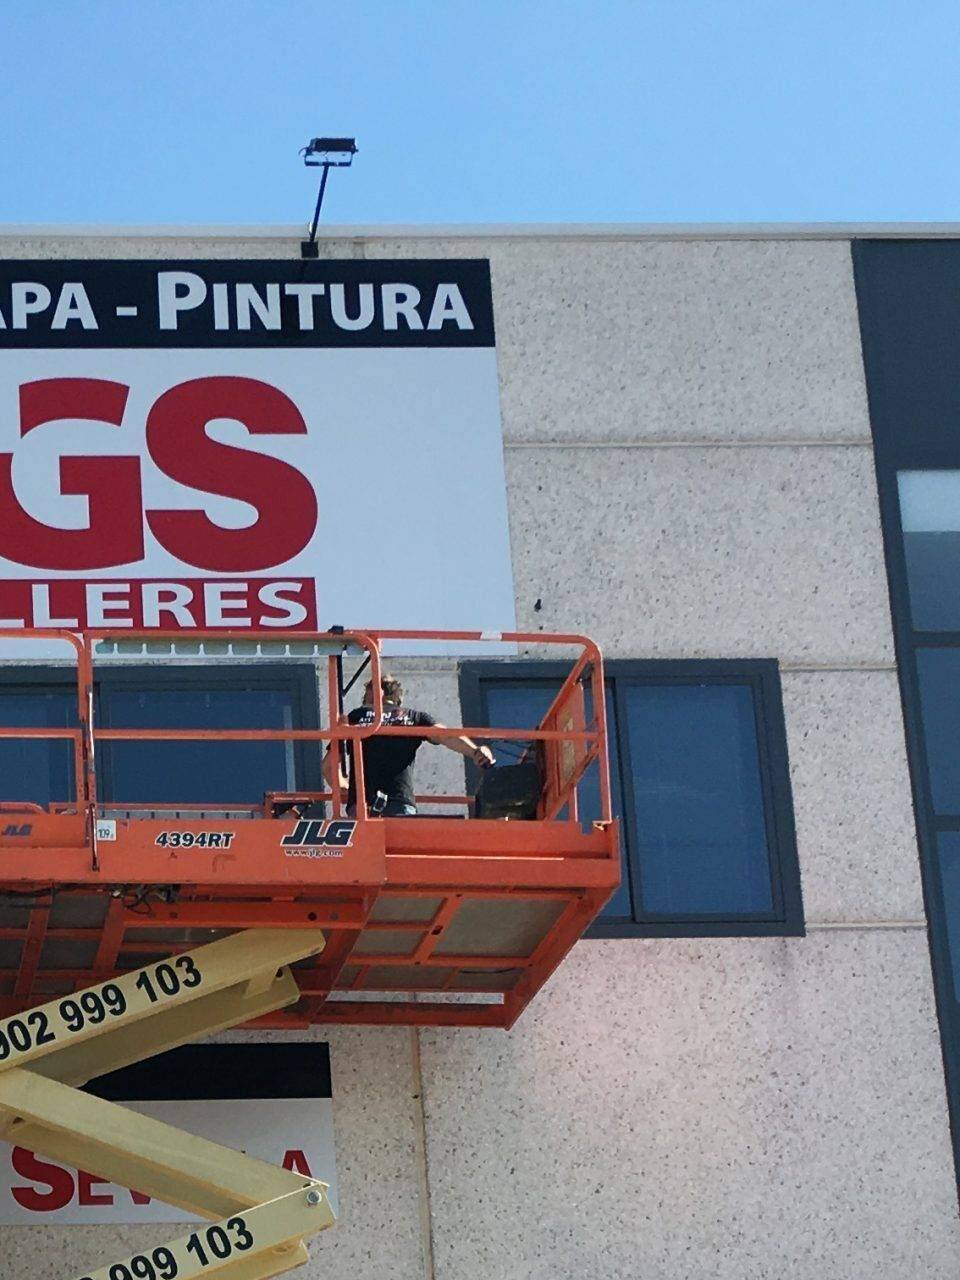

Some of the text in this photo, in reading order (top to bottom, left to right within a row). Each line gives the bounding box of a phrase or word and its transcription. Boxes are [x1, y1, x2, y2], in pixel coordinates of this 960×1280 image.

[159, 271, 474, 331] PINTURA
[155, 831, 236, 848] 4394RT
[280, 820, 357, 847] JLG
[59, 983, 127, 1033] 999
[135, 956, 203, 1003] 103
[186, 1217, 254, 1269] 103
